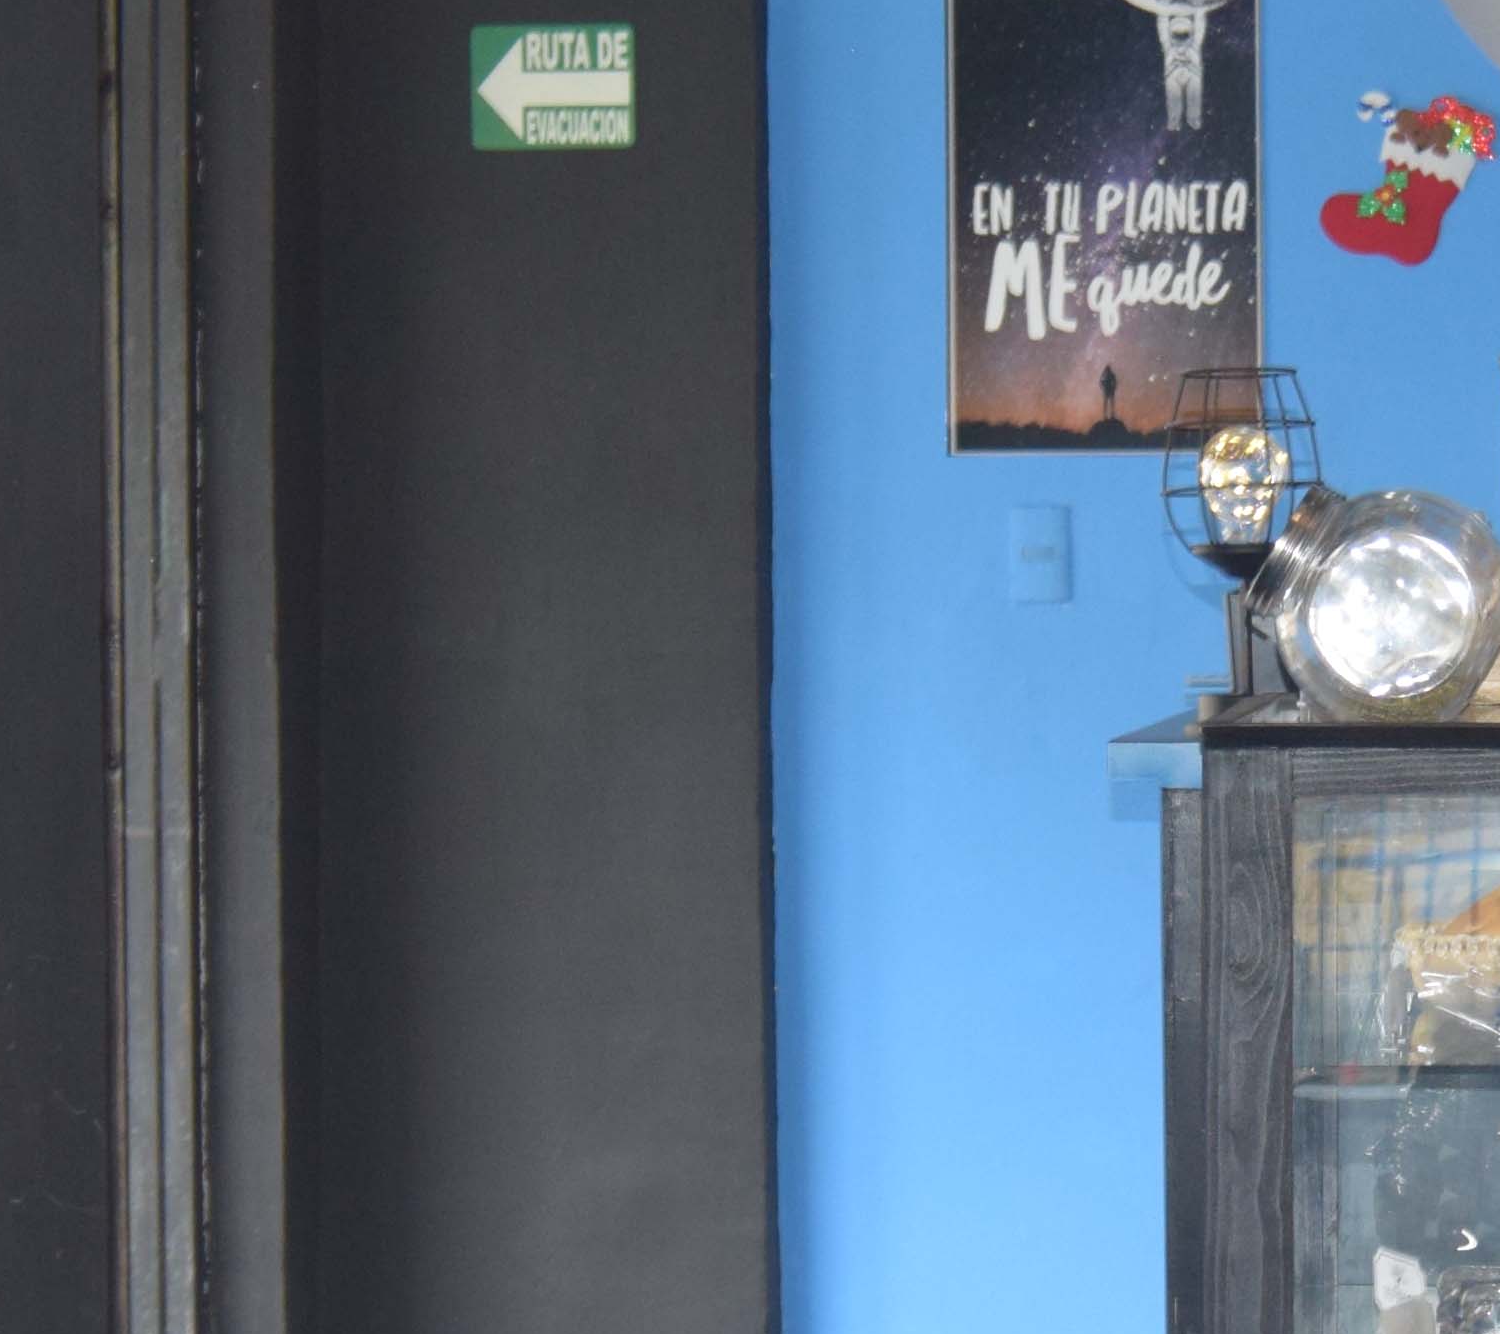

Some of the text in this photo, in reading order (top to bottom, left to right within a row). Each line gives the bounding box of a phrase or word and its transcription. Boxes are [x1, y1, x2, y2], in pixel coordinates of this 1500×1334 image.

[526, 30, 629, 70] RUTA DE
[972, 177, 1249, 239] EN TU PLANETA
[984, 232, 1081, 342] ME
